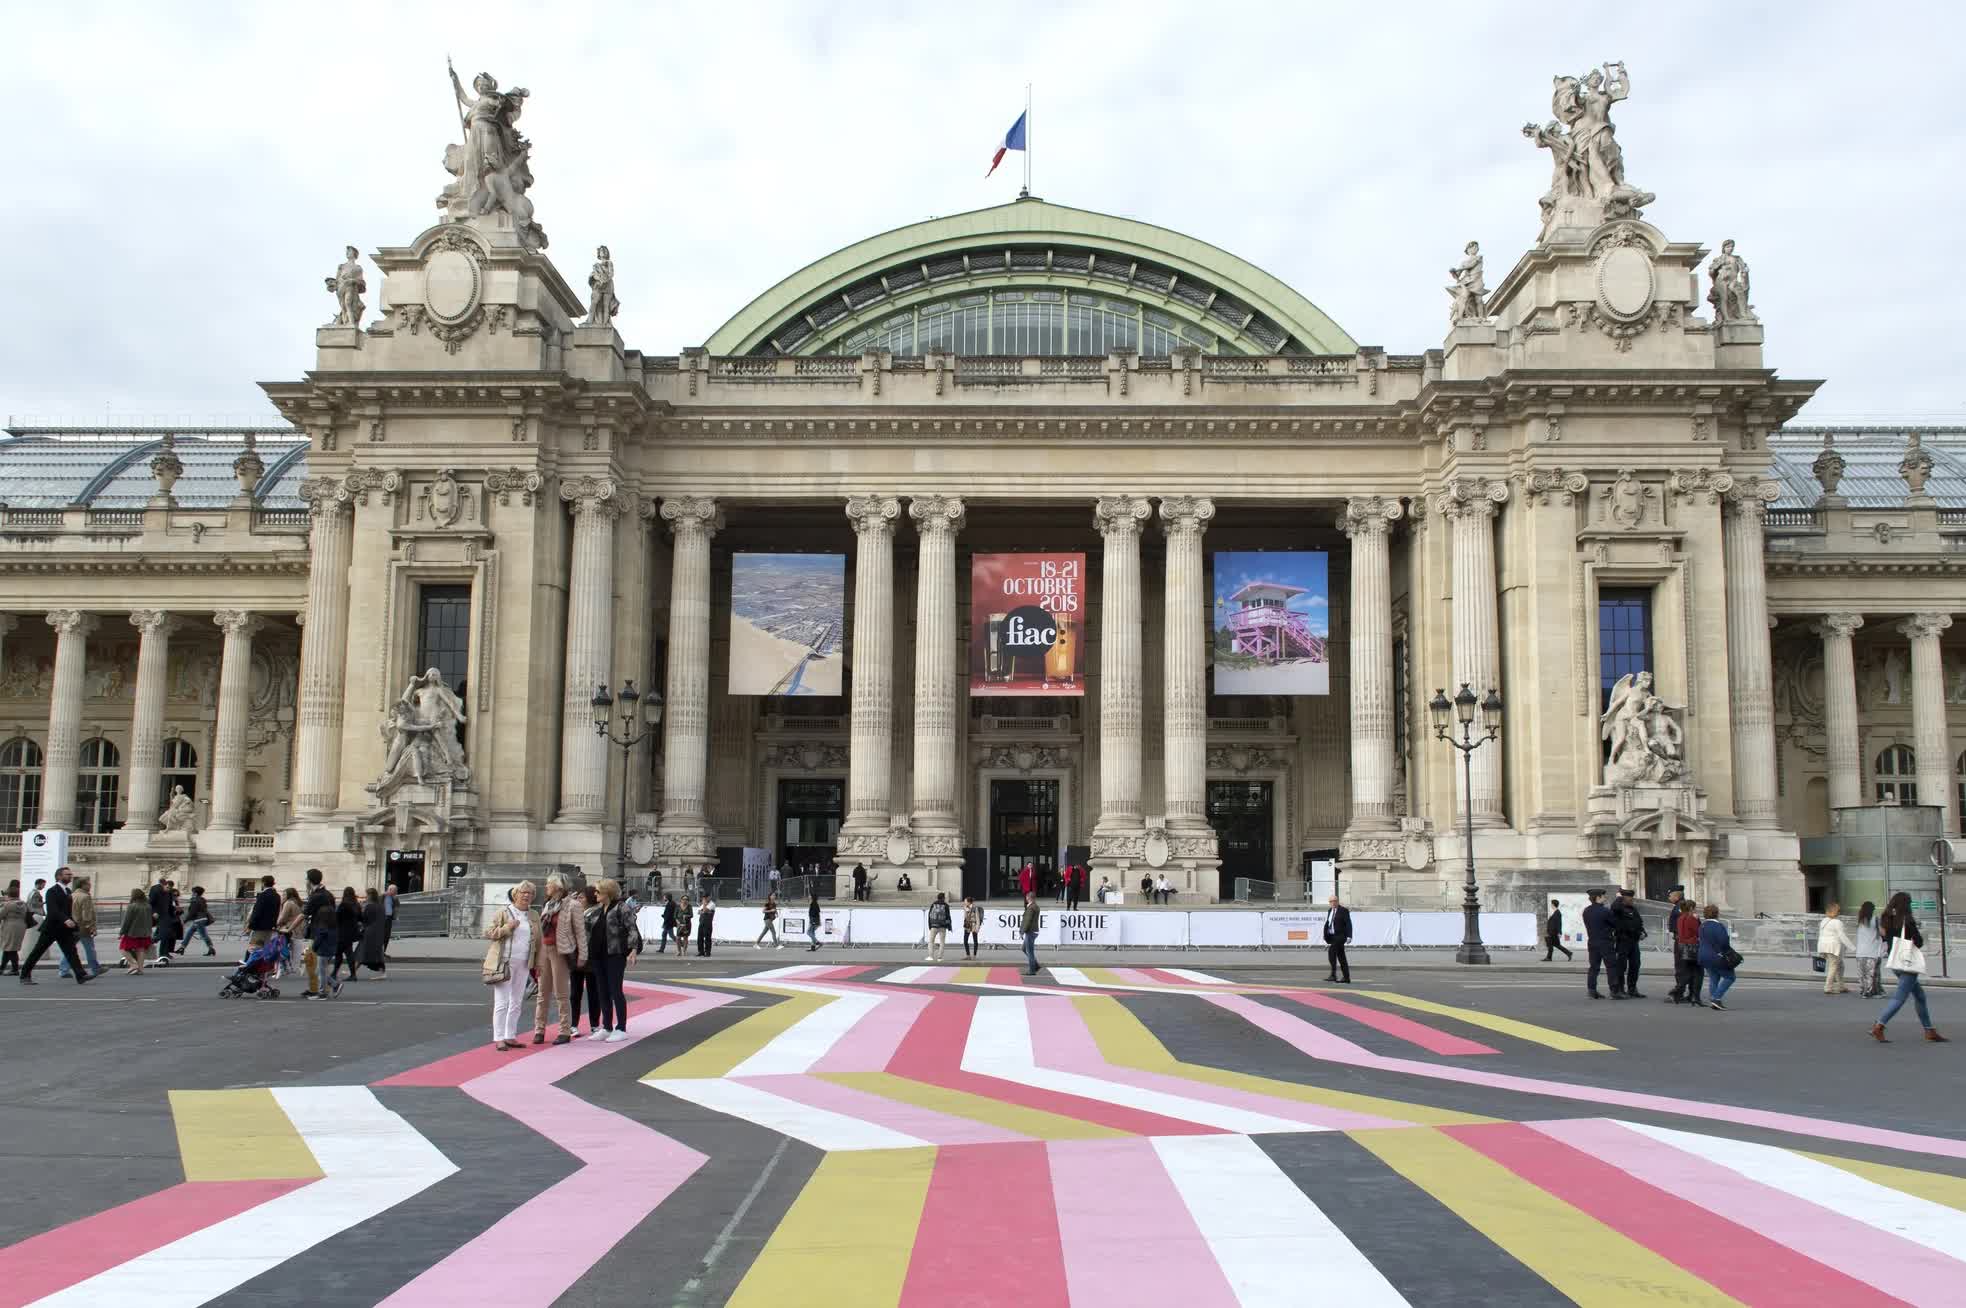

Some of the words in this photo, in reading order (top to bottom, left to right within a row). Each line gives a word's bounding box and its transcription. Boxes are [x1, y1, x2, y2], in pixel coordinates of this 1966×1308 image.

[1041, 560, 1078, 578] 18-21
[1003, 577, 1078, 595] OCTOBRE
[1040, 595, 1078, 612] 2018
[1005, 616, 1057, 646] fiac
[1061, 914, 1108, 929] SORTIE
[1072, 930, 1095, 941] EXIT
